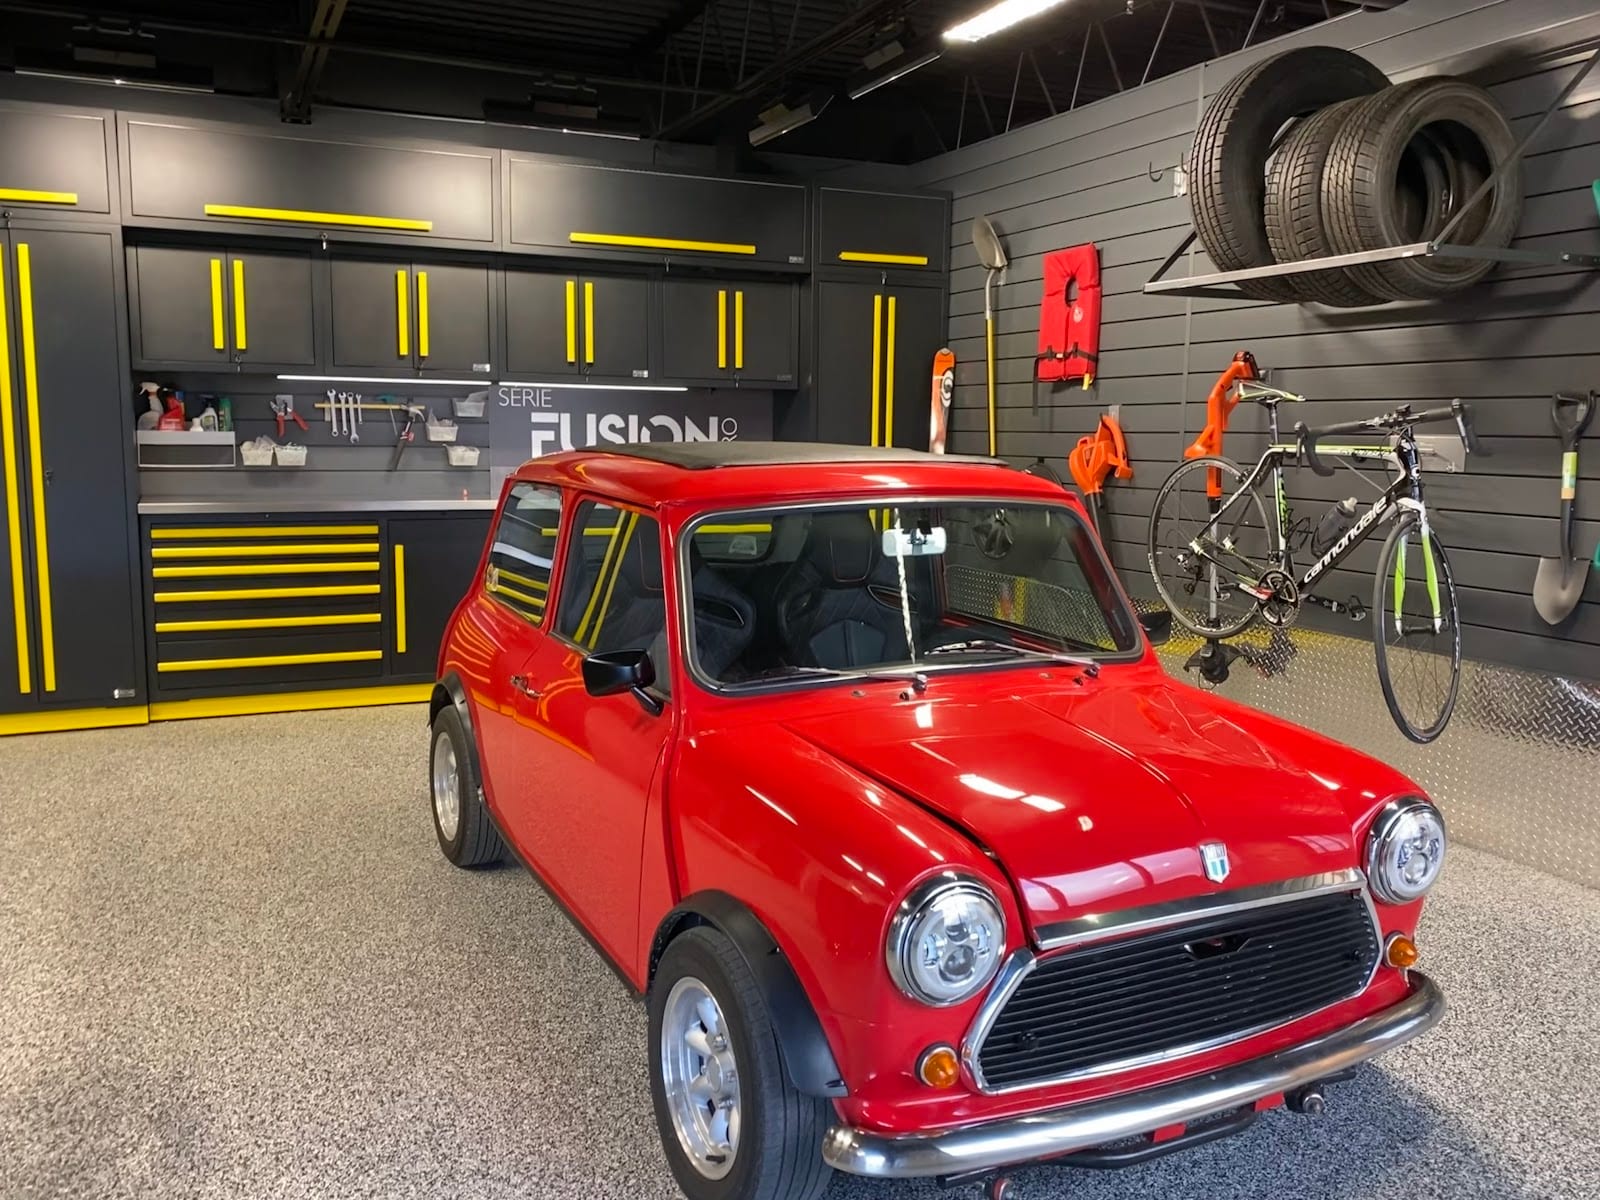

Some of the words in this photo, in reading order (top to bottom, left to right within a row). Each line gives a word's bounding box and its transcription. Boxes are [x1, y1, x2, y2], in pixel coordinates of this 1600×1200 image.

[498, 385, 552, 408] SÉRIE
[721, 417, 738, 442] RO
[1304, 496, 1387, 583] cannondale
